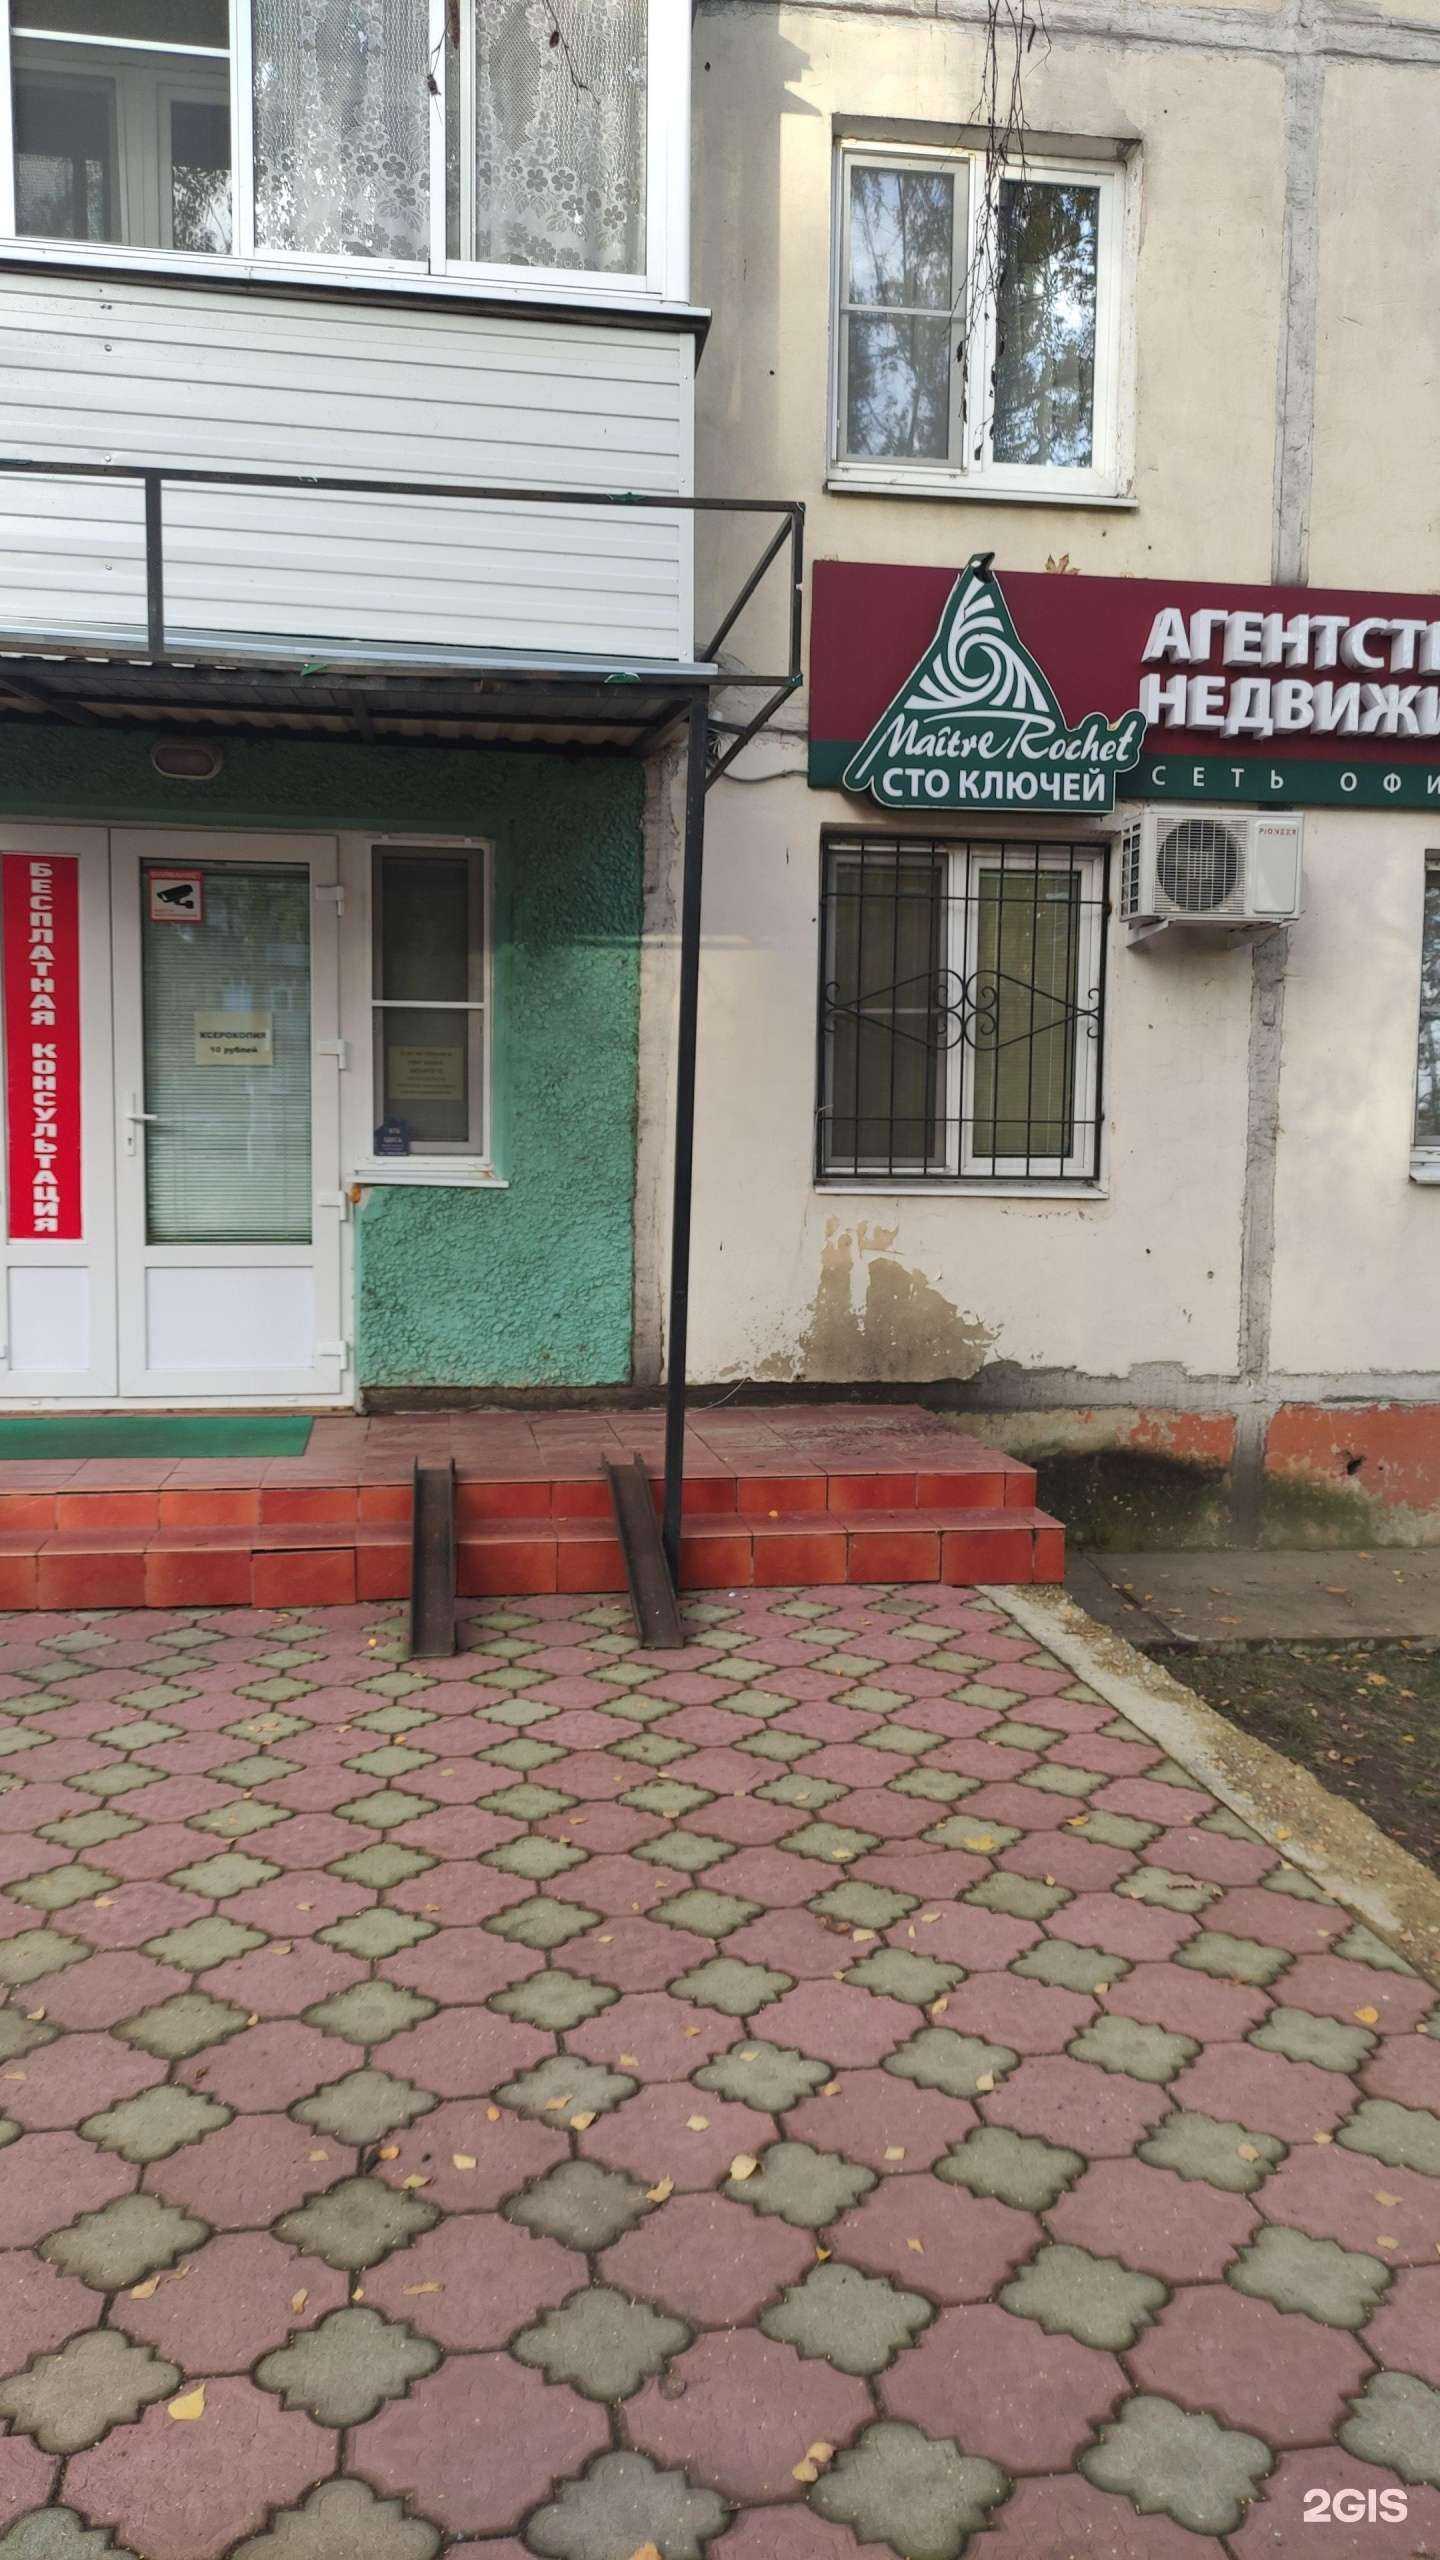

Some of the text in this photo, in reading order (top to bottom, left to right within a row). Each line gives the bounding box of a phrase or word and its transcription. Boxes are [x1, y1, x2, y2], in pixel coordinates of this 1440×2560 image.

[924, 710, 1137, 762] Rochet
[882, 767, 1105, 801] СТО КЛЮЧЕЙ
[1151, 765, 1285, 790] СЕТЬ
[1258, 827, 1296, 836] PIONEER
[28, 862, 60, 1232] БЕСПЛАТНАЯ КОНСУЛЬТАЦИЯ
[199, 1031, 266, 1039] КСЕРОКОПИЯ
